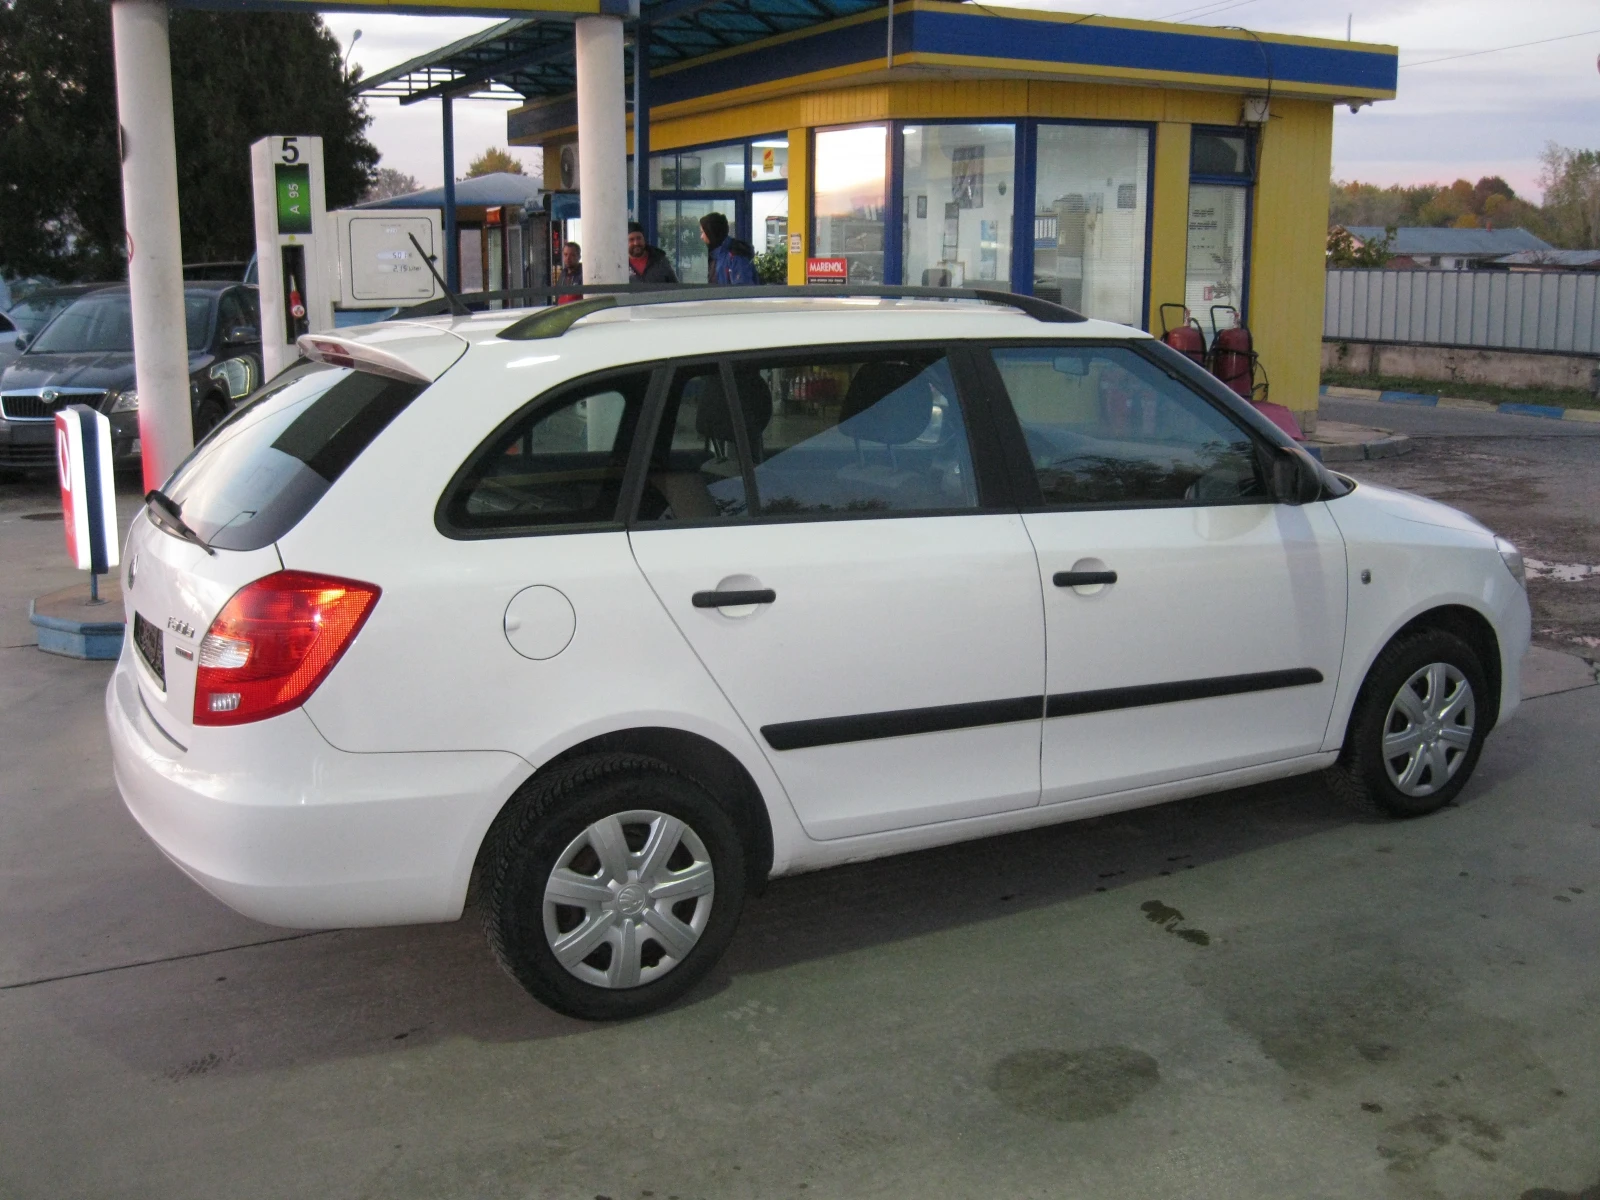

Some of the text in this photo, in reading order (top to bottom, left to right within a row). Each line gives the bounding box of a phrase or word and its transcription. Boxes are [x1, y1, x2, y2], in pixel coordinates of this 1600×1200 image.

[282, 137, 300, 164] 5
[288, 183, 300, 215] A 95
[809, 261, 844, 273] MARENOL
